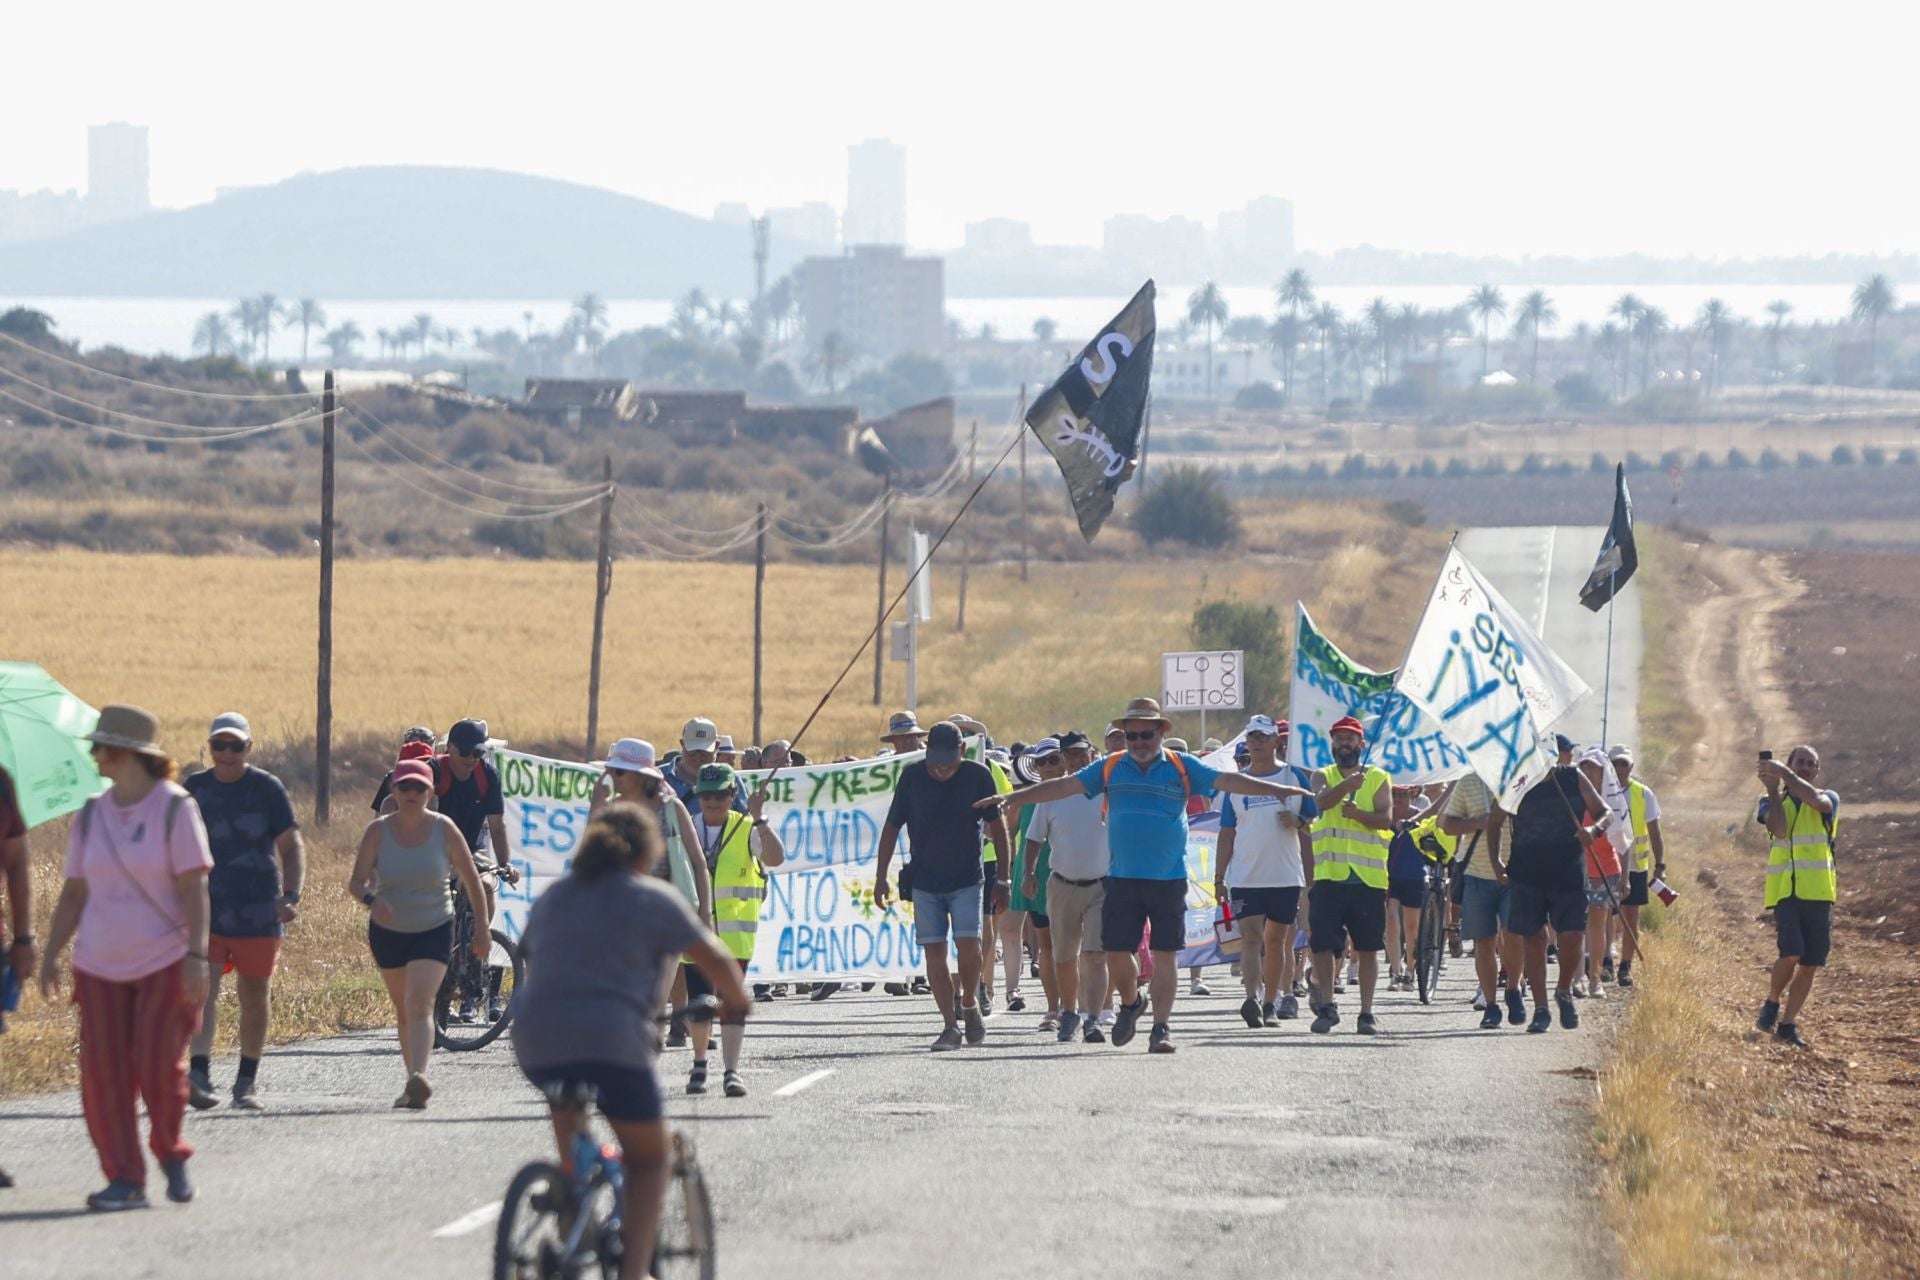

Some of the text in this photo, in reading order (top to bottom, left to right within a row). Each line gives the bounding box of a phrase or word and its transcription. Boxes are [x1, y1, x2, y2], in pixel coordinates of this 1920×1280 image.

[1165, 688, 1238, 706] NIETOS
[1382, 729, 1468, 775] SUFR
[777, 920, 923, 973] ABANDON
